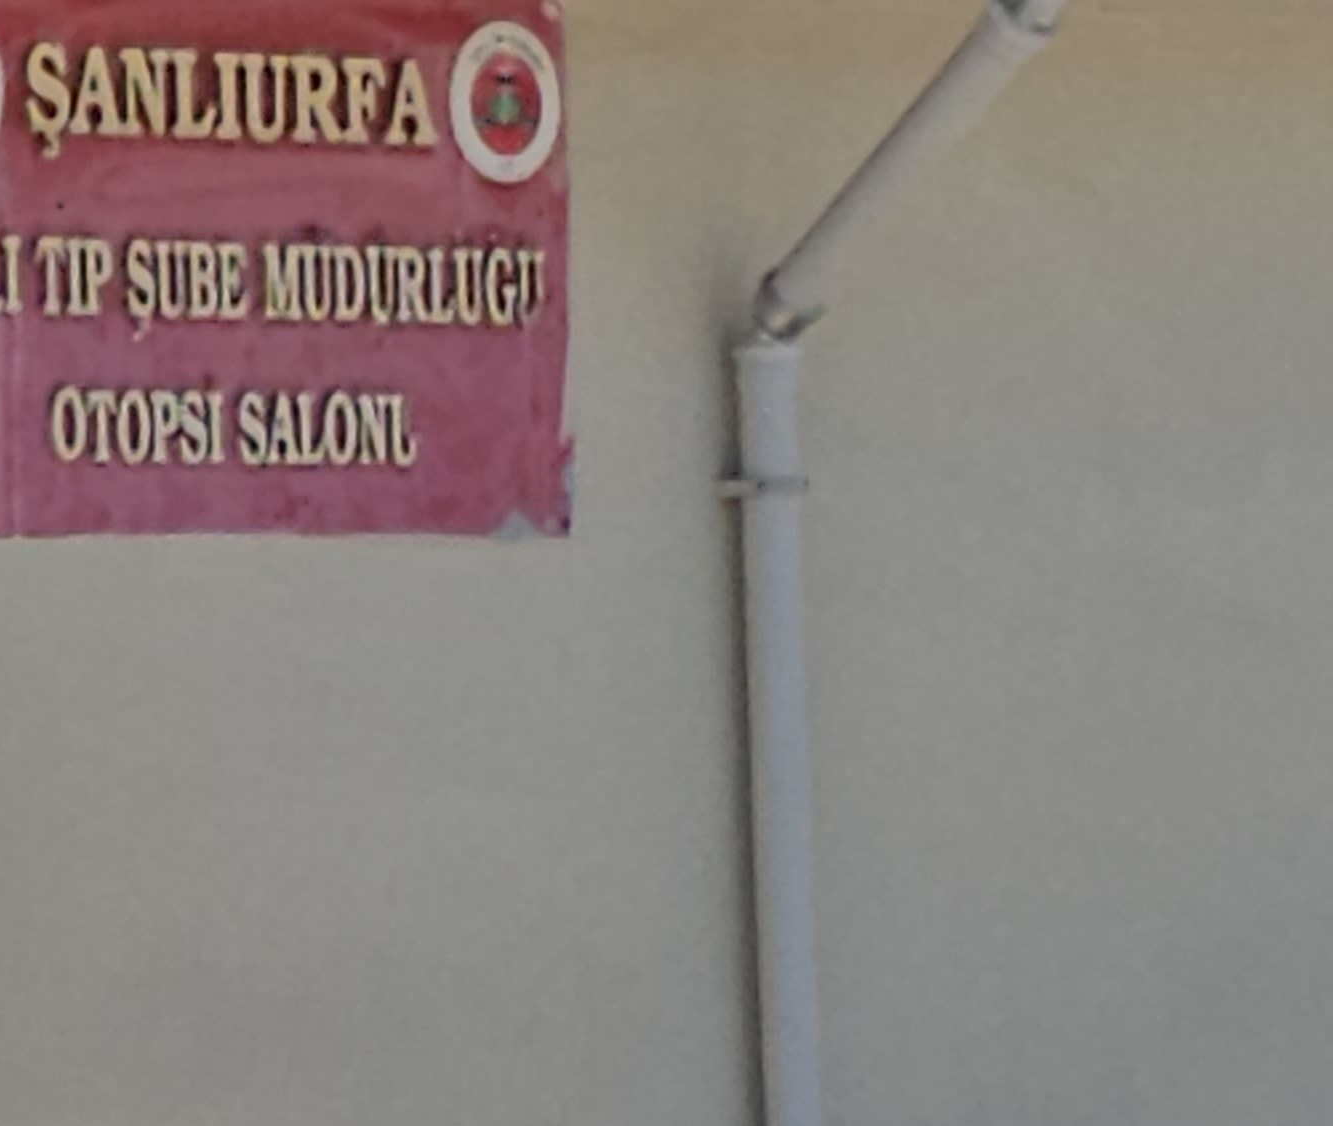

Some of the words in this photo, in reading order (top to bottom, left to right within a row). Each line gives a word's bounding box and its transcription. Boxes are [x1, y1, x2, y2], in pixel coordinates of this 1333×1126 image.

[25, 41, 439, 158] ŞANLIURFA
[35, 235, 114, 316] TIP
[127, 238, 249, 342] ŞUBE
